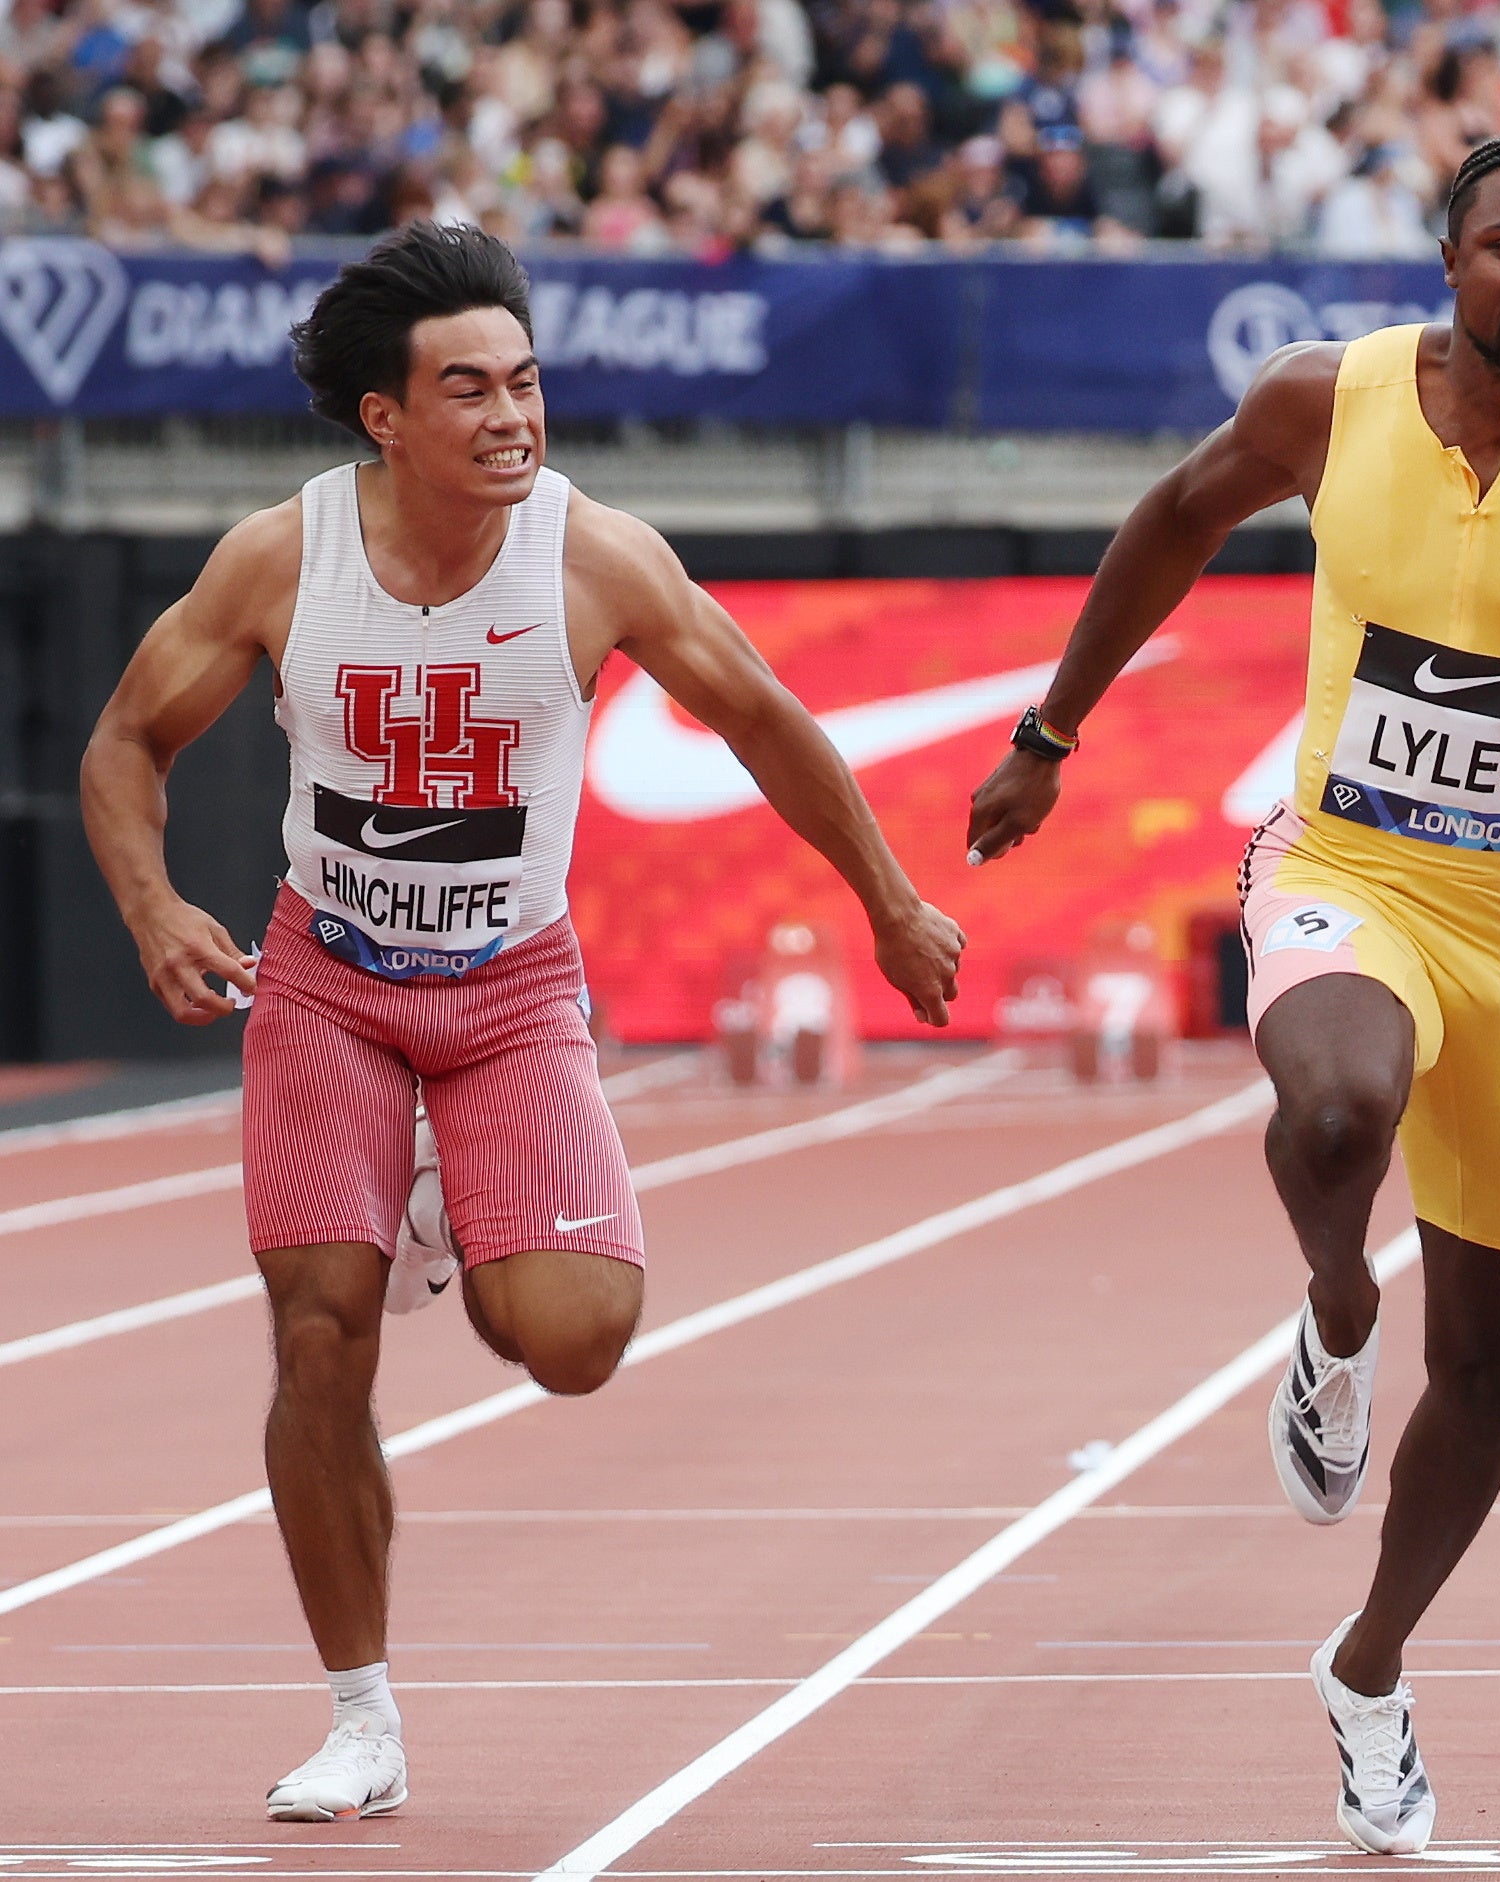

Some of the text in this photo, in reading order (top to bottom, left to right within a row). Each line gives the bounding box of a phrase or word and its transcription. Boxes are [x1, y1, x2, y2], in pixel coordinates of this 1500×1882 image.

[127, 280, 769, 377] DIAM EAGUE
[320, 856, 511, 934] HINCHLIFFE
[1293, 910, 1330, 936] 5
[380, 951, 475, 972] LONDO
